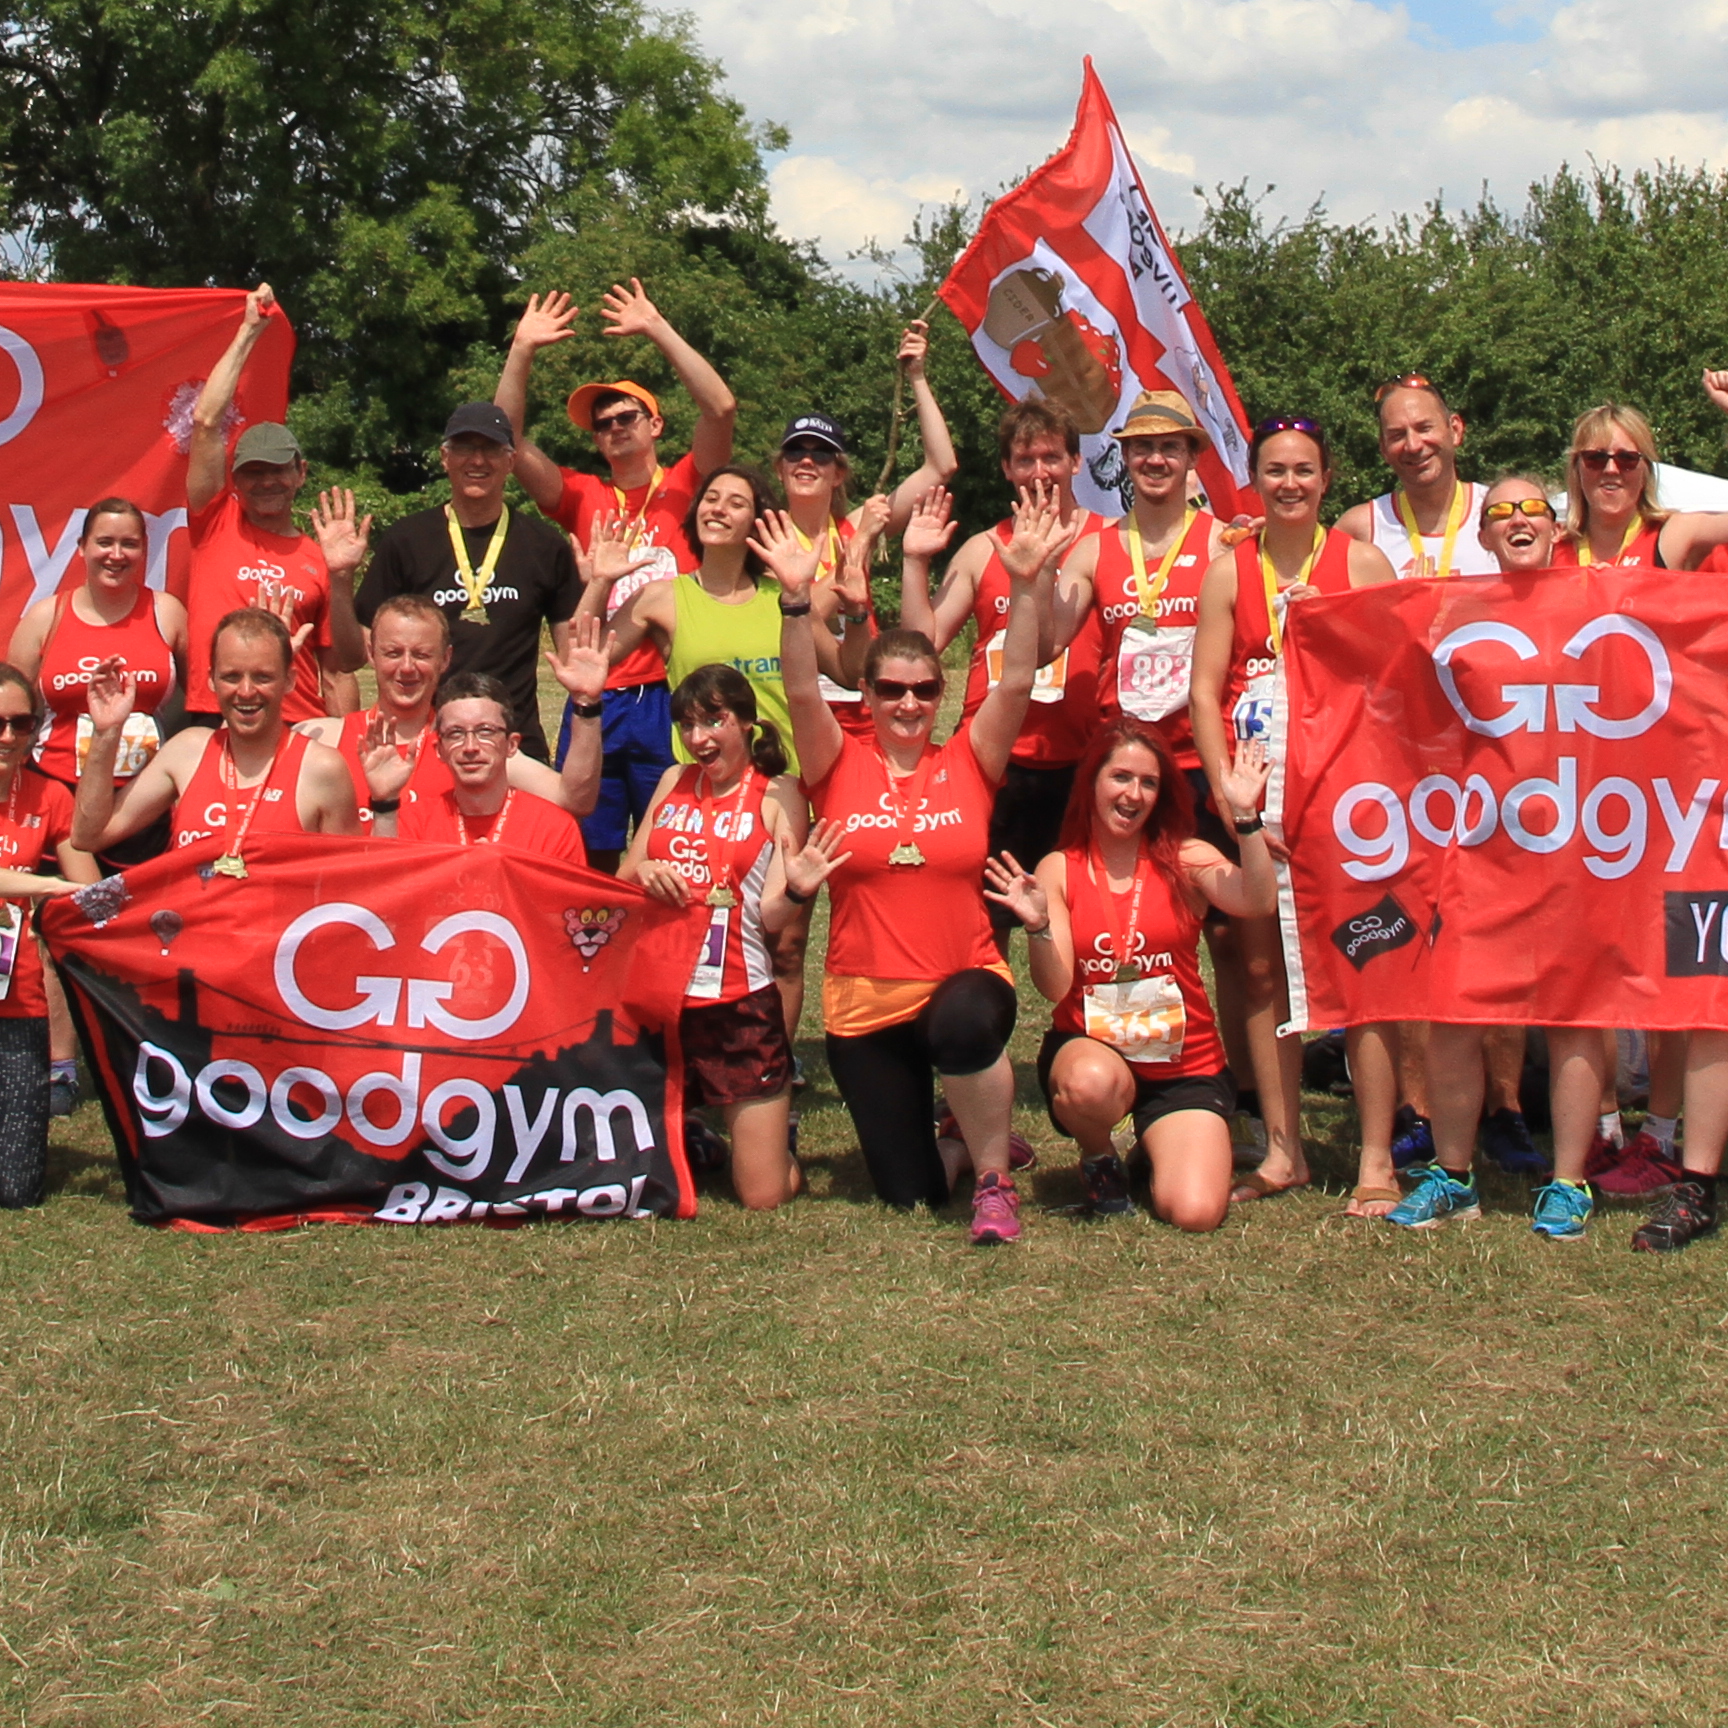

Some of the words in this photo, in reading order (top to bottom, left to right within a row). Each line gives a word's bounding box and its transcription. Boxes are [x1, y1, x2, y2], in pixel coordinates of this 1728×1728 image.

[433, 586, 519, 607] googym
[1238, 698, 1273, 740] 15
[1346, 917, 1406, 957] goodgym
[1102, 1008, 1171, 1046] 365
[133, 1041, 656, 1183] goodgym
